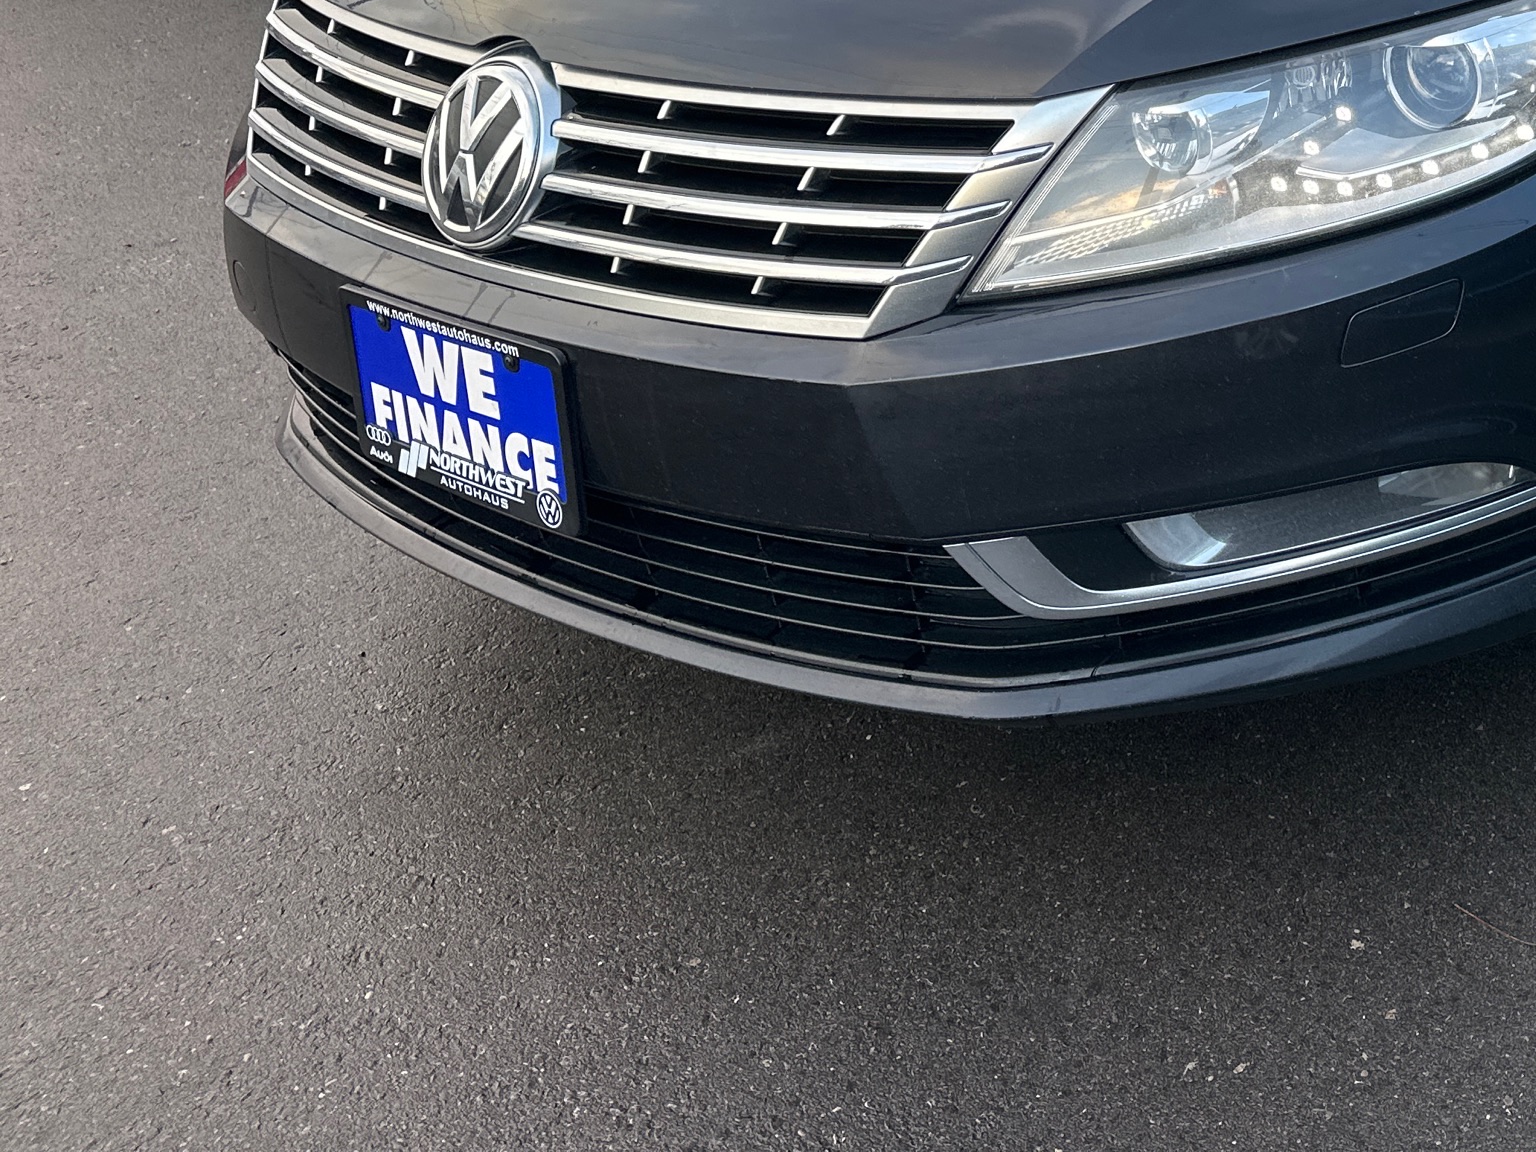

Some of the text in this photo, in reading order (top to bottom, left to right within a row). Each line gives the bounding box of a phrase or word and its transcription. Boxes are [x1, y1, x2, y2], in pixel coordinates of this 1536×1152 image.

[366, 300, 519, 358] www.northwestautohaus.com
[400, 325, 501, 420] WE
[371, 381, 559, 495] FINANCE
[429, 448, 526, 498] NORTHWEST
[440, 475, 509, 509] AUTOHAUS
